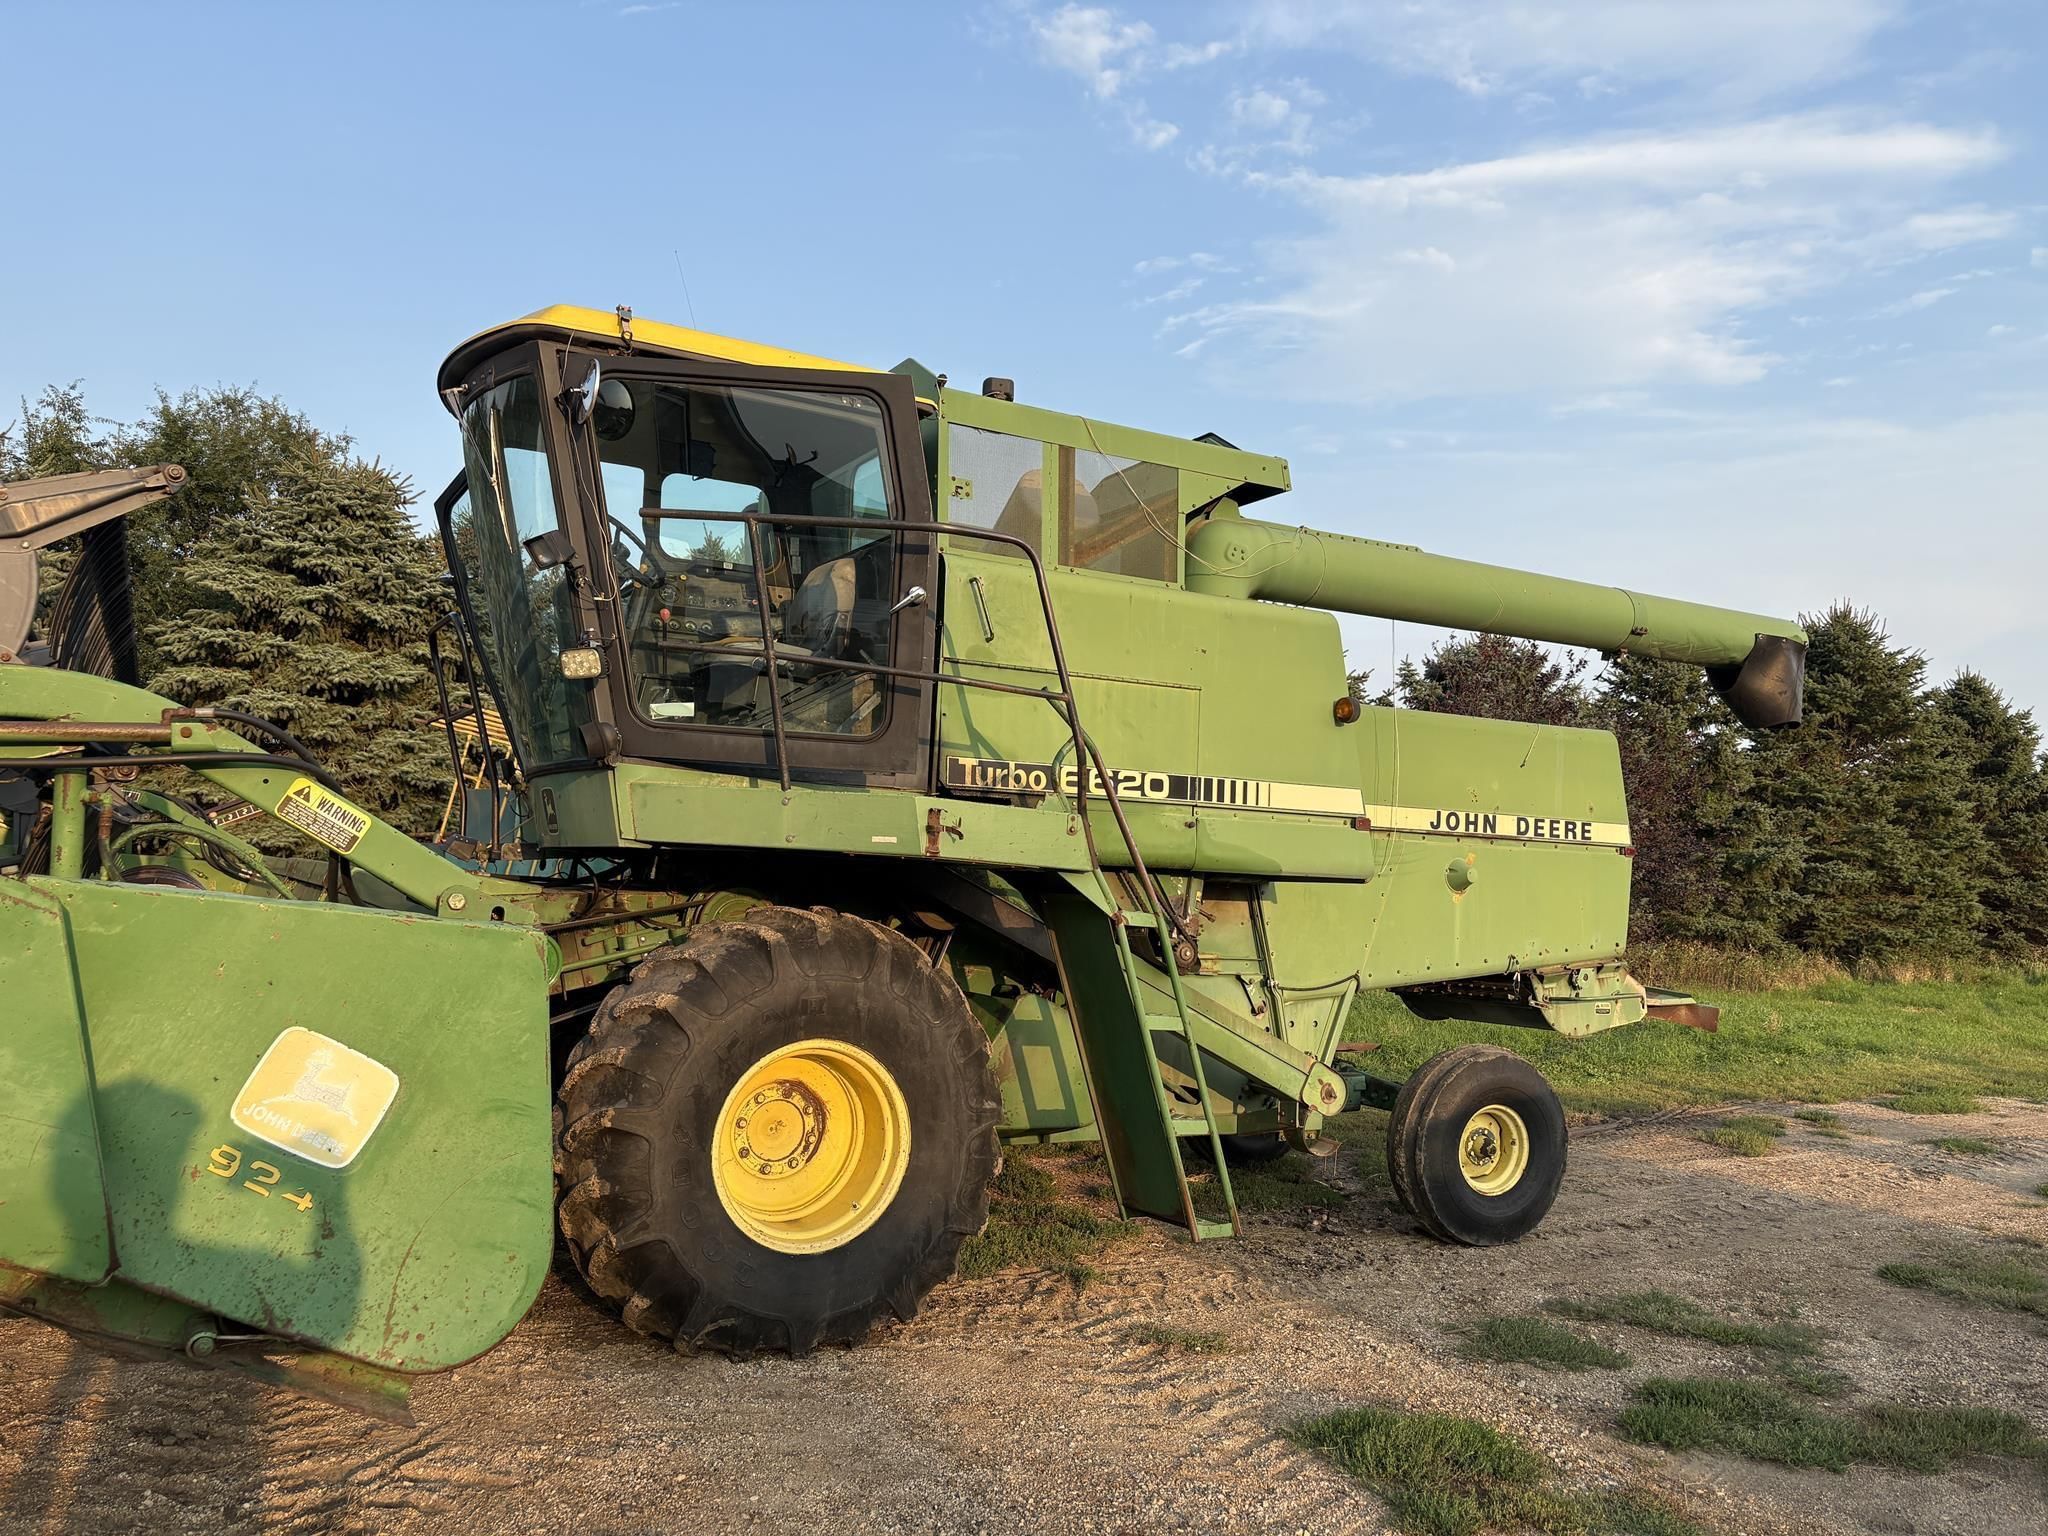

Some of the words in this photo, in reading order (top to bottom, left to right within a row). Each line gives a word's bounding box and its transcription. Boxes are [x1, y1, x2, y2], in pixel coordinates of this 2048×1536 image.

[958, 758, 1047, 791] Turbo
[1060, 764, 1169, 799] 6620
[317, 797, 366, 833] WARNING
[1430, 810, 1497, 834] JOHN
[1516, 816, 1592, 840] DEERE
[242, 1104, 291, 1131] JOHN
[291, 1122, 345, 1157] DEERE
[207, 1144, 313, 1212] 924
